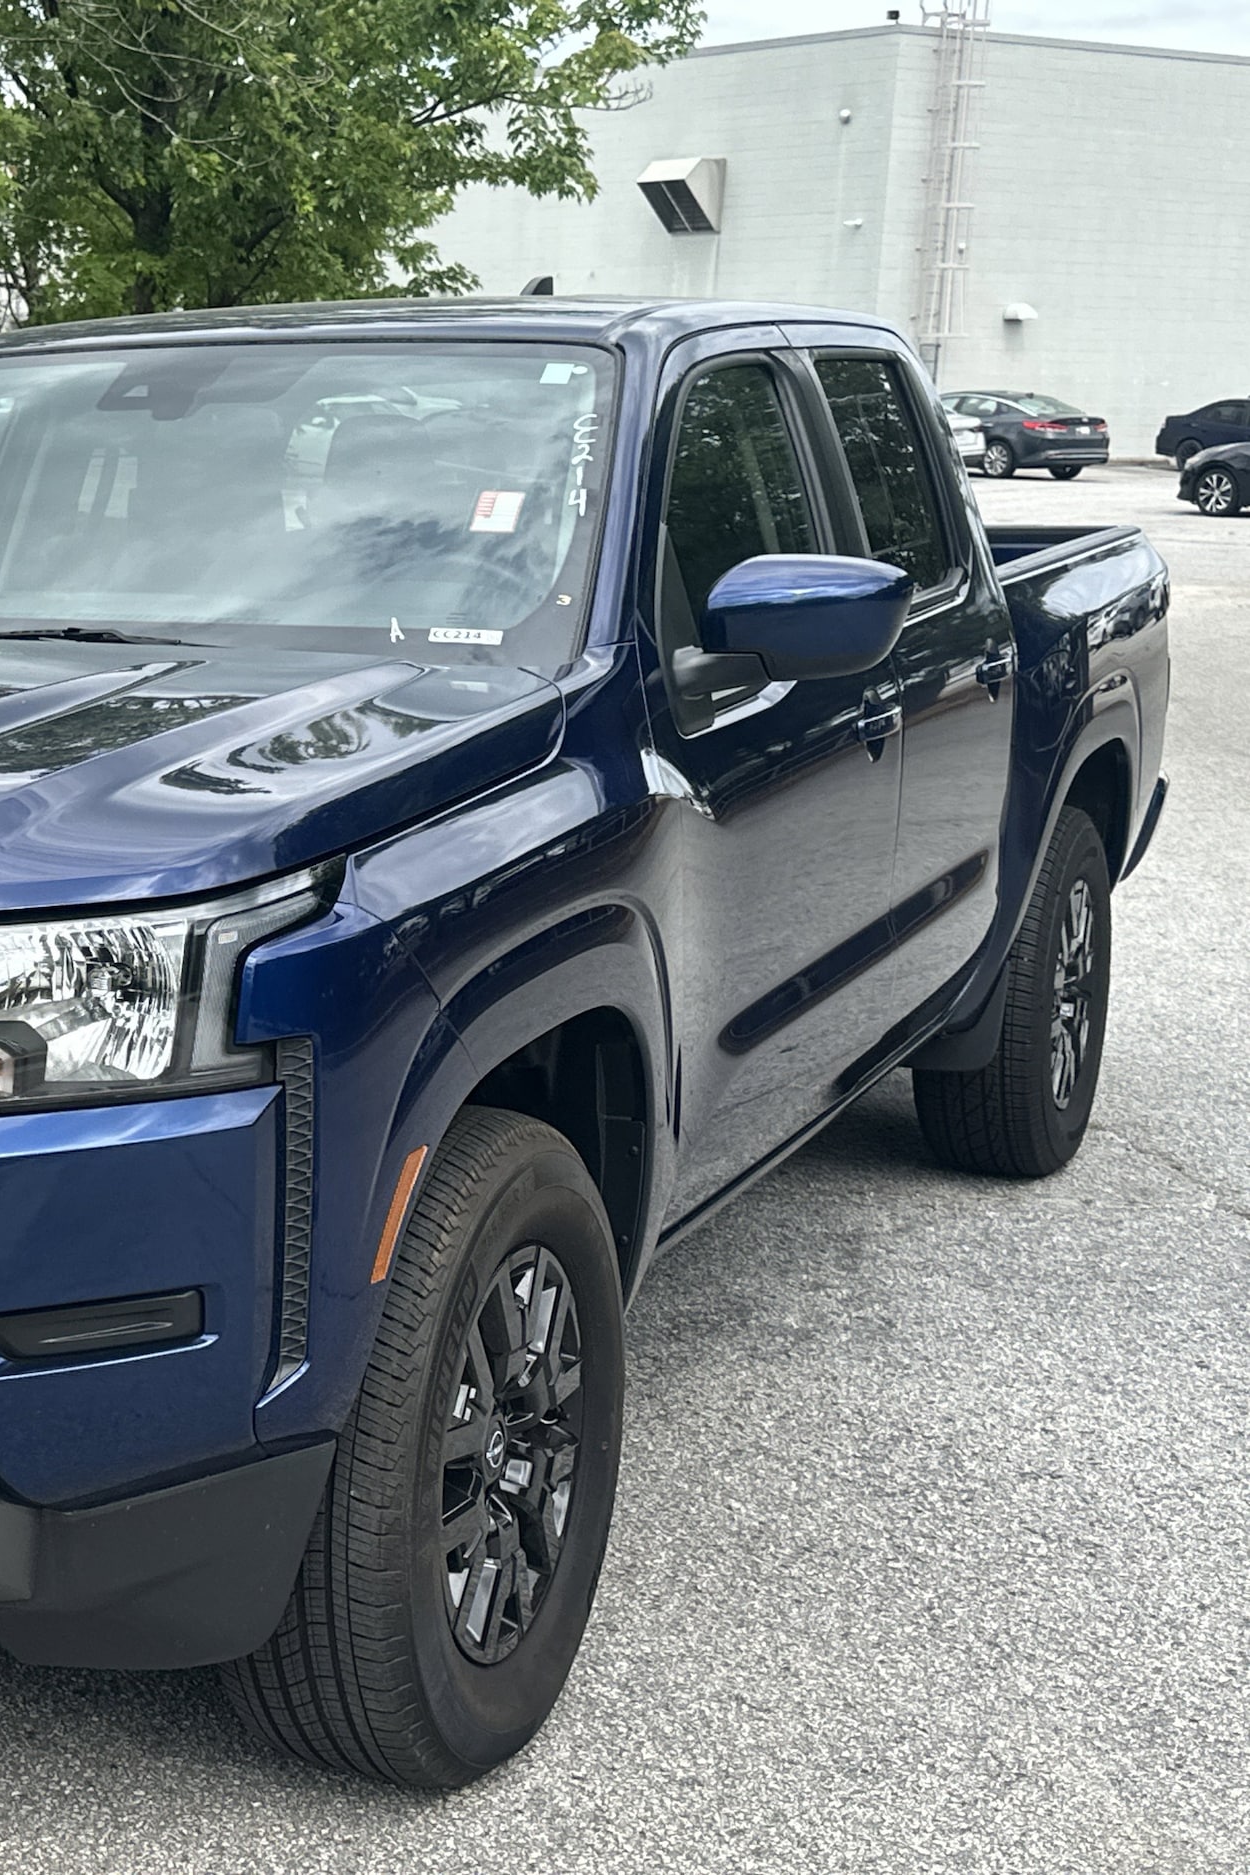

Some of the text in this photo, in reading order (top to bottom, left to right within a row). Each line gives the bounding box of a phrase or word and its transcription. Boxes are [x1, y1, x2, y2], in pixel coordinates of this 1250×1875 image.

[389, 616, 405, 643] A
[433, 630, 482, 640] CC214
[426, 1268, 477, 1472] MICHELIN
